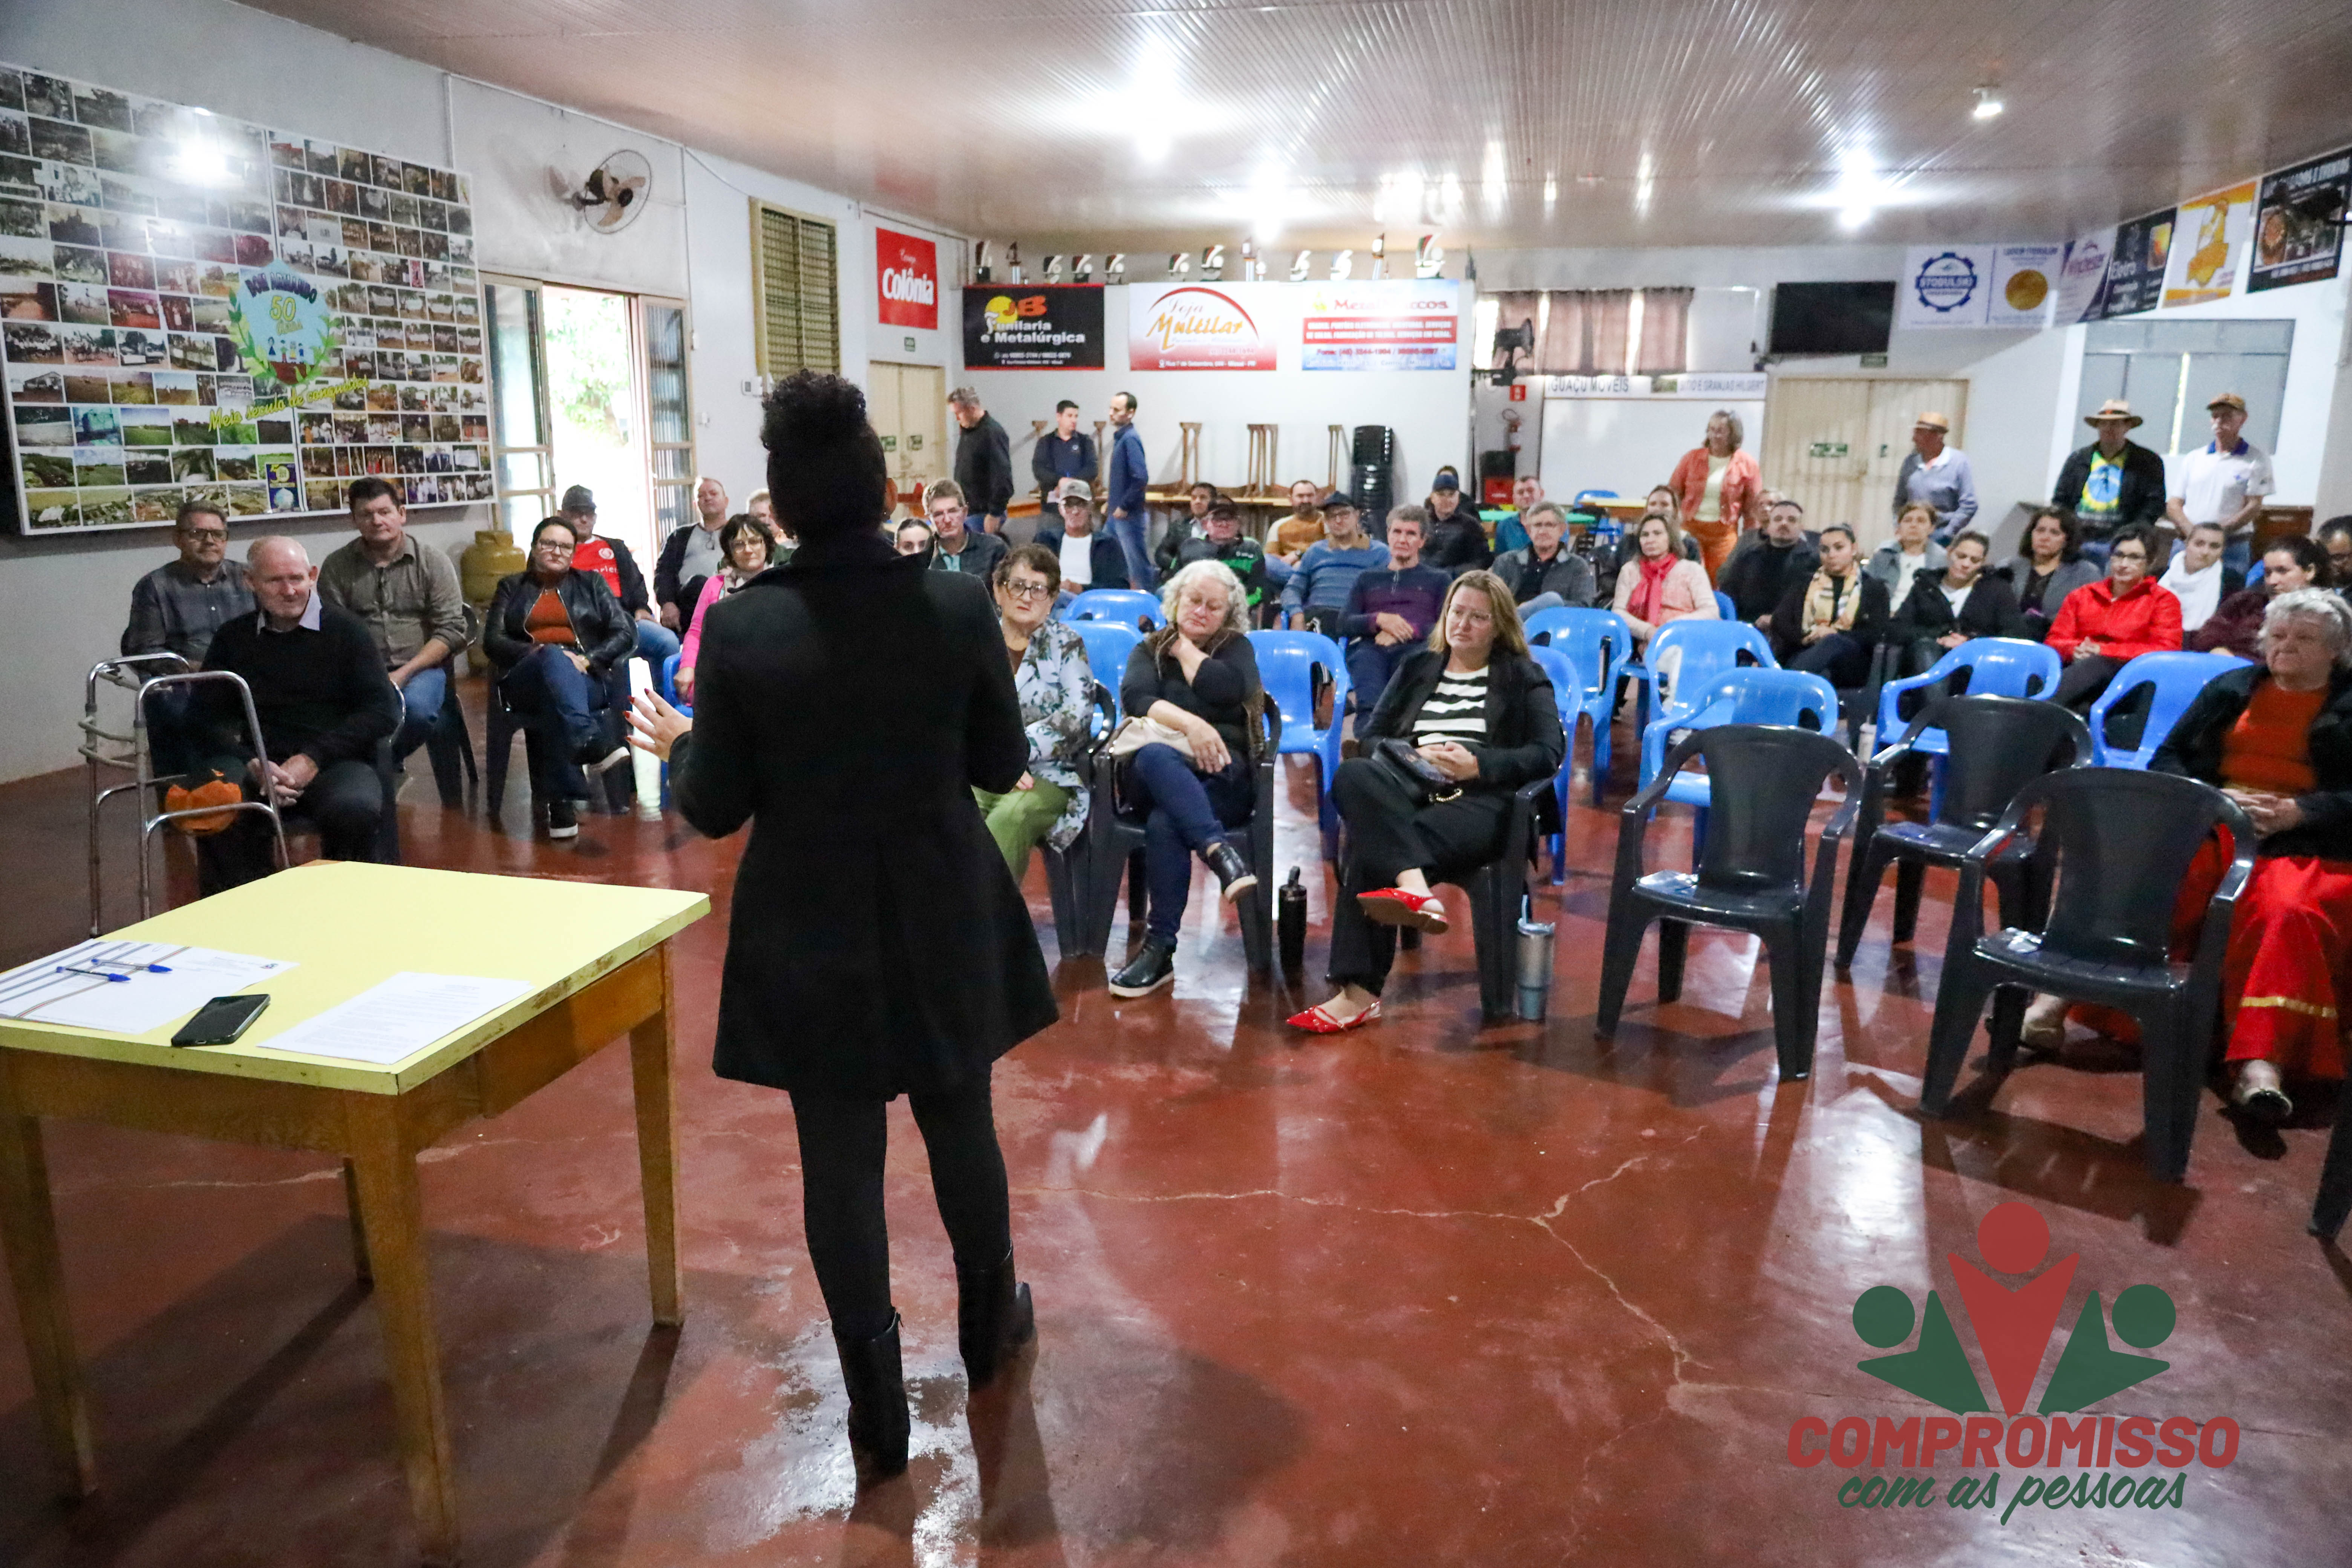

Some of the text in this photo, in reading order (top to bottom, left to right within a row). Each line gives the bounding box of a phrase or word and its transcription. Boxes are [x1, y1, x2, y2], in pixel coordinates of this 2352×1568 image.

[882, 267, 934, 306] Colônia
[270, 296, 296, 321] 50
[984, 311, 1052, 334] Funilaria
[981, 331, 1085, 345] e Metalúrgica
[1146, 312, 1243, 351] Multilar
[208, 407, 243, 432] Meio
[289, 387, 305, 407] de
